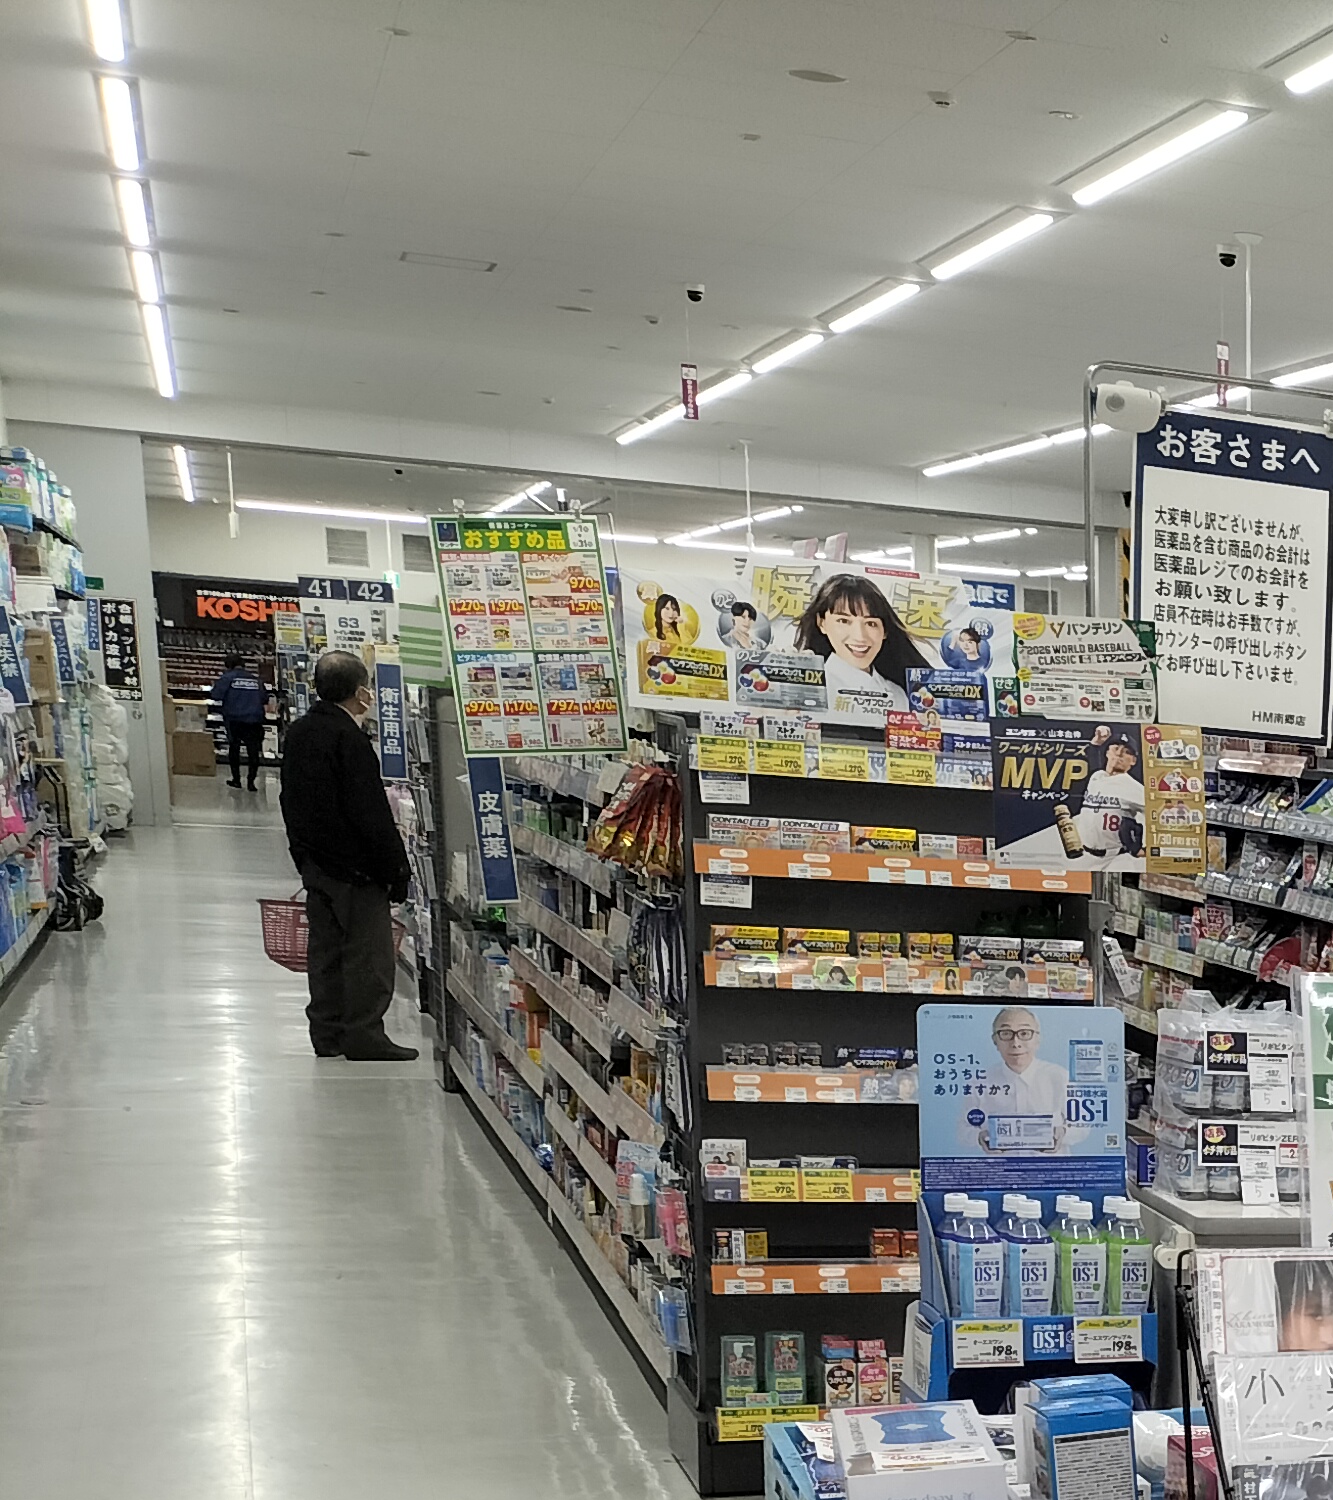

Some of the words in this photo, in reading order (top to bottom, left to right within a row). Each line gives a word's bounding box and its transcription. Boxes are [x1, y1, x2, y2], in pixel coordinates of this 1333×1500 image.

[1156, 424, 1321, 474] お客さまへ
[1154, 505, 1305, 543] 大変申し訳ございませんが、
[464, 529, 567, 550] おすすめ品
[1154, 530, 1310, 565] 医薬品を含む商品のお会計は
[1154, 553, 1309, 590] 医薬品レジでのお会計を
[308, 579, 332, 598] 41
[357, 583, 384, 601] 42
[1155, 579, 1297, 613] お願い致します。
[1067, 622, 1124, 637] バンテリン
[1153, 603, 1301, 638] 店員不在時はお手数ですが、
[1052, 644, 1086, 655] WORLD
[1088, 642, 1132, 653] BASEBALL
[1154, 630, 1307, 661] カウンターの呼び出しボタン
[1037, 655, 1077, 666] CLASSIC
[380, 686, 402, 755] 衛生用品
[1252, 710, 1307, 727] HM南郷店
[998, 741, 1090, 756] ワールドシリーズ
[1000, 756, 1089, 790] MVP
[477, 790, 508, 859] 皮膚薬
[1102, 812, 1121, 832] 18
[933, 1067, 987, 1082] おうちに
[933, 1084, 1011, 1098] ありますか?
[1066, 1098, 1109, 1123] OS-1
[1021, 1266, 1049, 1284] OS-1
[1072, 1266, 1099, 1284] OS-1
[1122, 1266, 1148, 1284] OS-1
[1032, 1329, 1066, 1350] OS-1
